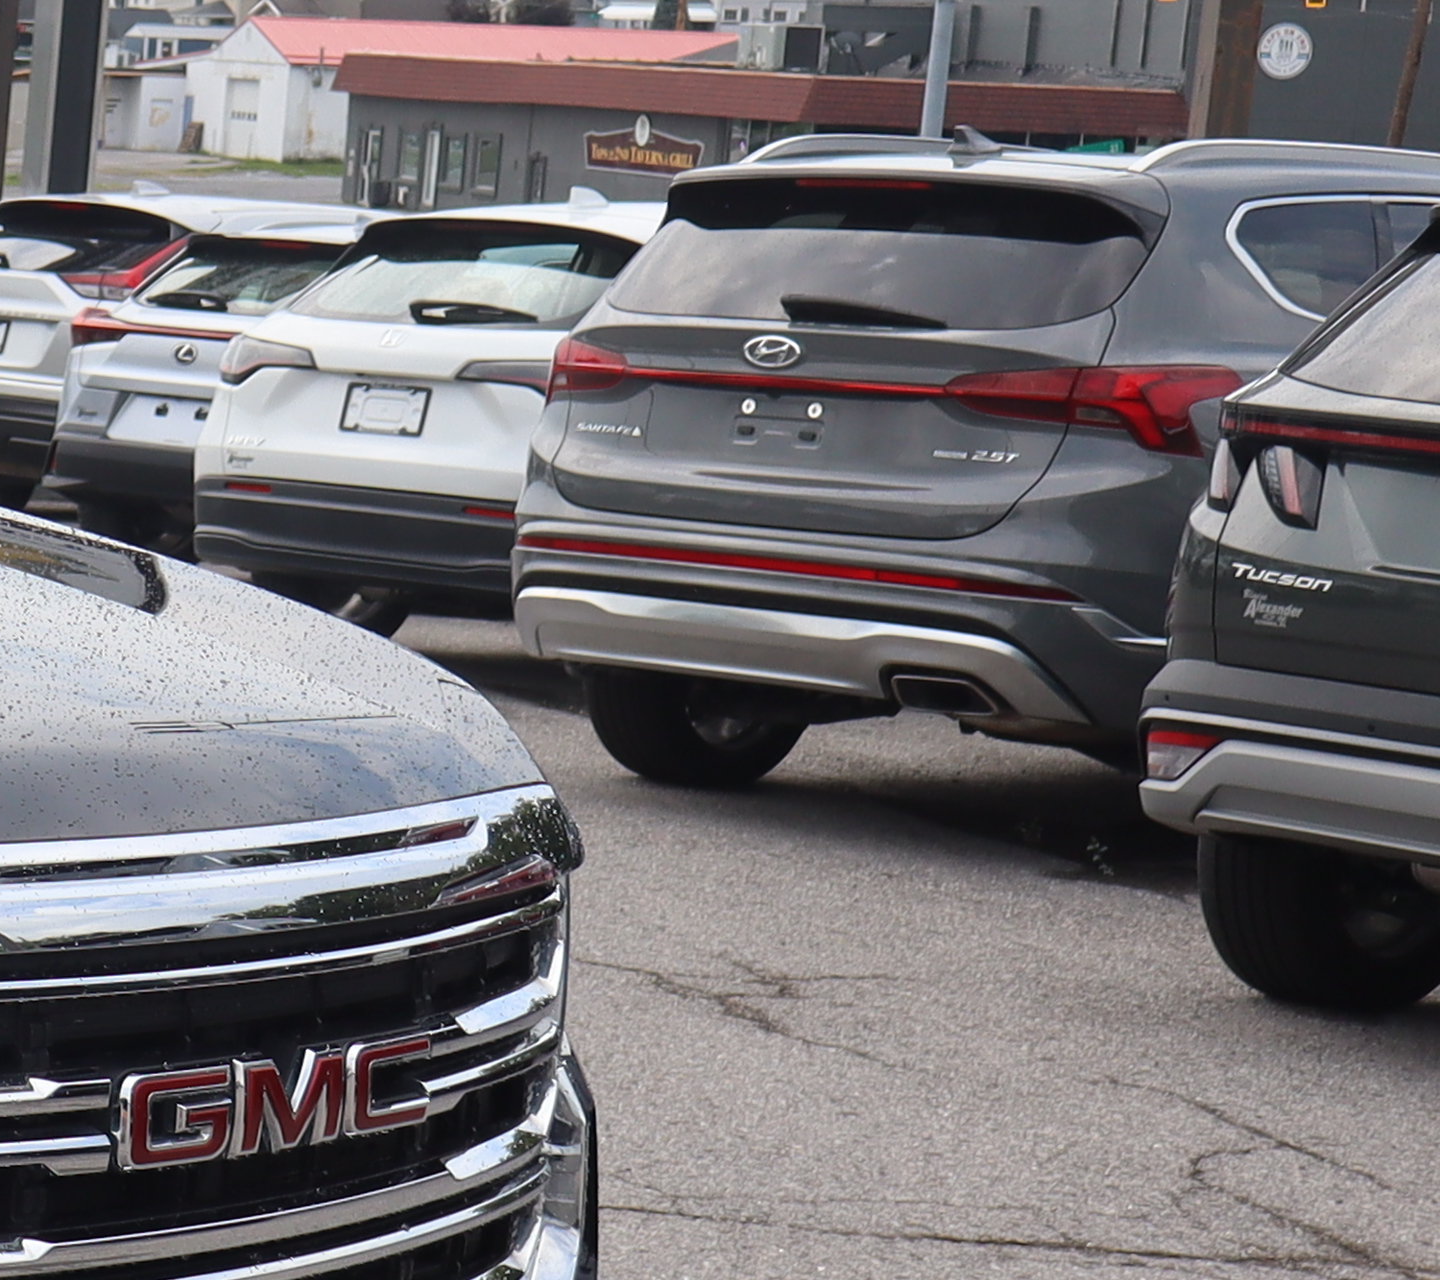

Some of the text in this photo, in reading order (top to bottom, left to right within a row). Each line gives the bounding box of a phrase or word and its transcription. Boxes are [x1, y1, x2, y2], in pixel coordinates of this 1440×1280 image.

[1231, 562, 1334, 593] TUCSON
[1242, 598, 1305, 619] Alexander
[116, 1039, 431, 1170] GMC
